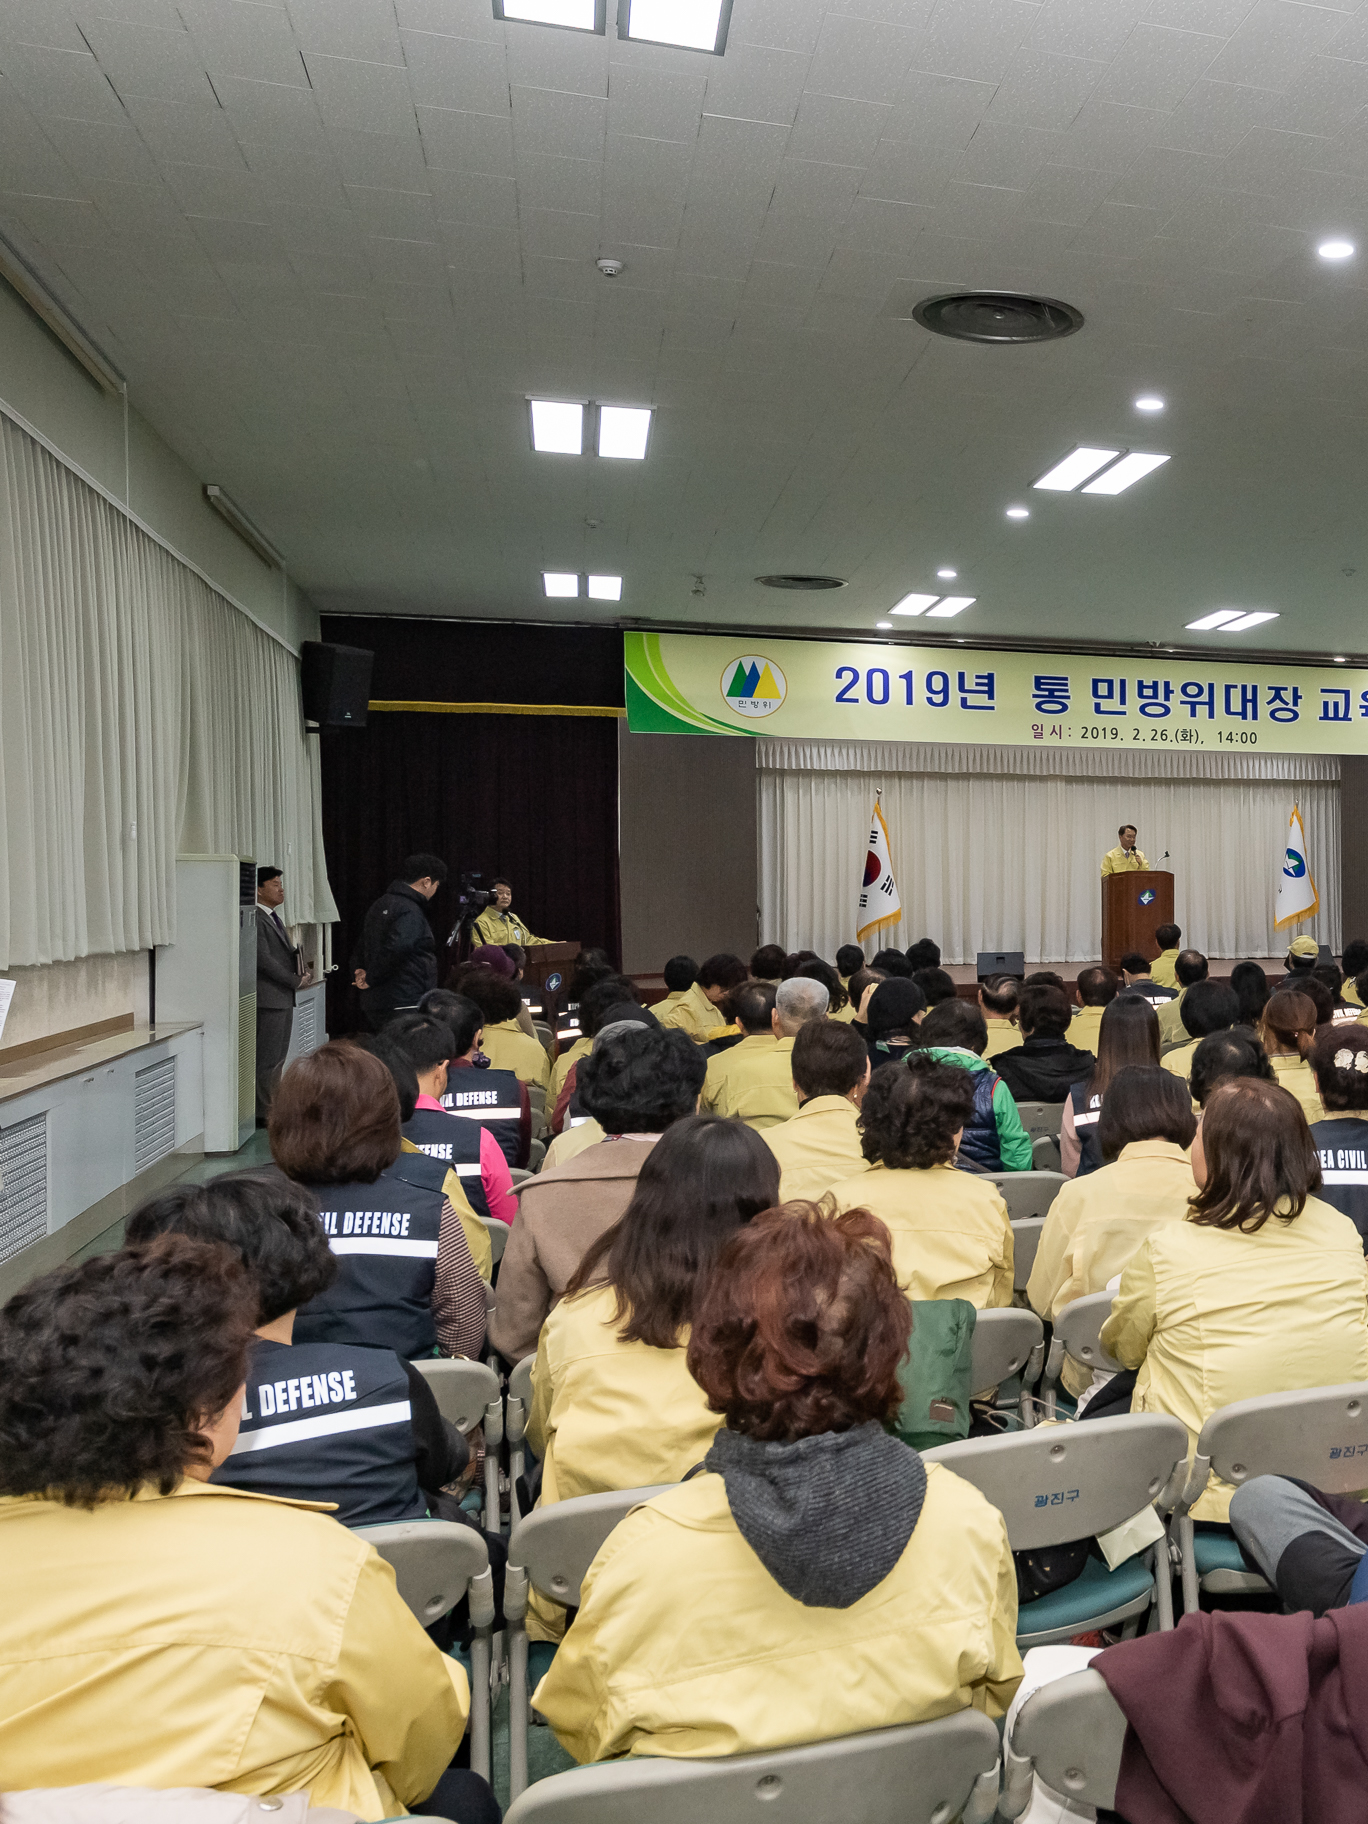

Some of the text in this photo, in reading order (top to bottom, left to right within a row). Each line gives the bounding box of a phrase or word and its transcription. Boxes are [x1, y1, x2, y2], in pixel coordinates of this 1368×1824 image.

[834, 665, 996, 711] 2019년
[1031, 674, 1072, 715] 통
[1091, 677, 1303, 723] 민방위대장
[1080, 726, 1124, 741] 2019.
[1217, 731, 1258, 745] 14:00
[456, 1091, 498, 1107] DEFENSE
[1337, 1149, 1367, 1170] CIVIL
[342, 1211, 411, 1236] DEFENSE
[258, 1369, 357, 1417] DEFENSE
[1329, 1443, 1368, 1460] 광진구
[1034, 1488, 1080, 1507] 광진구
